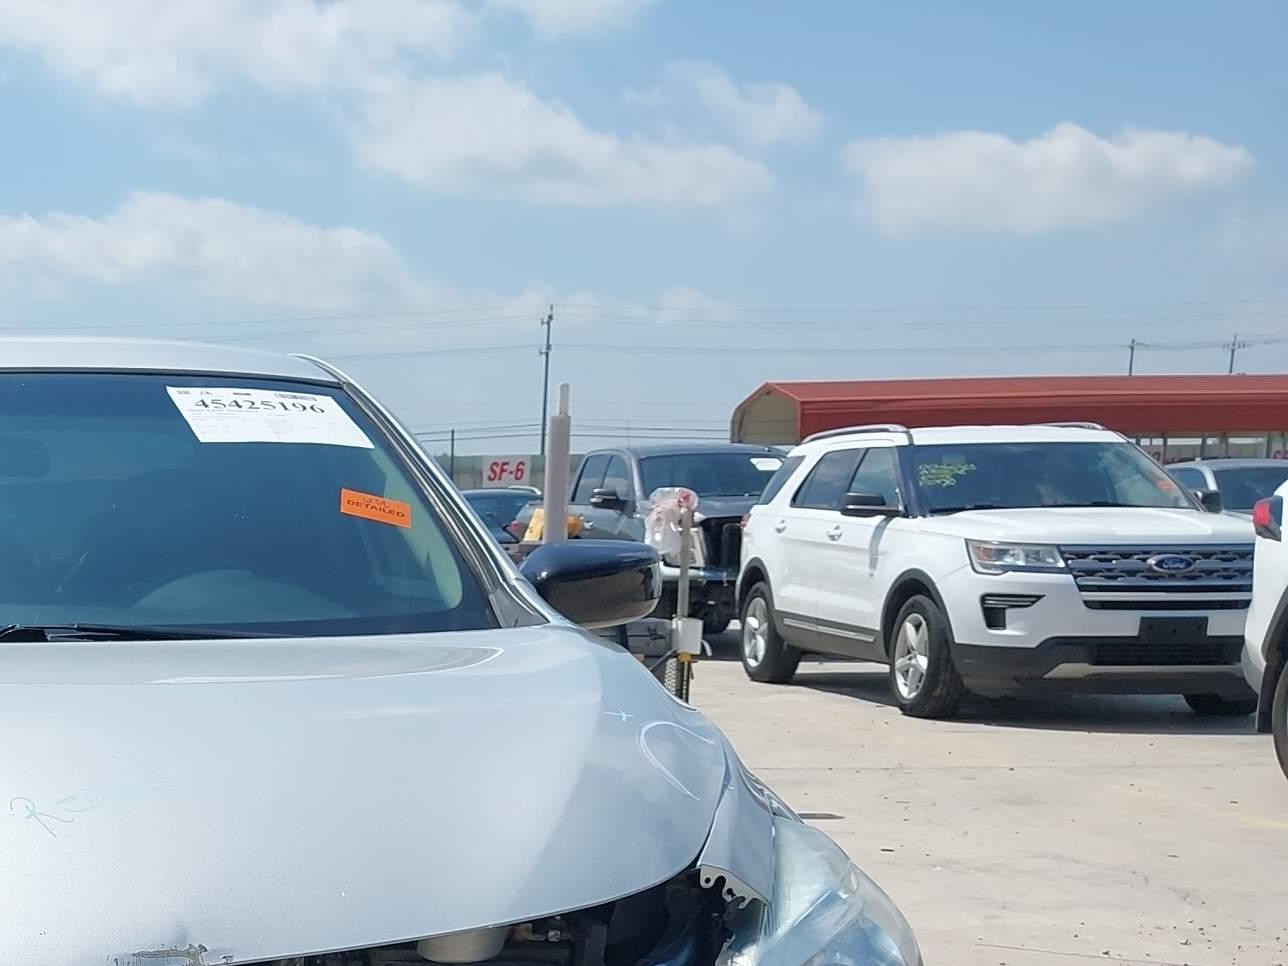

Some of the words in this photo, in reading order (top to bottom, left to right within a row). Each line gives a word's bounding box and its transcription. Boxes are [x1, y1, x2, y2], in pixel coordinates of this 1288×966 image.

[194, 398, 326, 415] 45425196
[488, 461, 525, 481] SF-6
[346, 499, 406, 518] DETAILED
[1162, 559, 1186, 569] Ford
